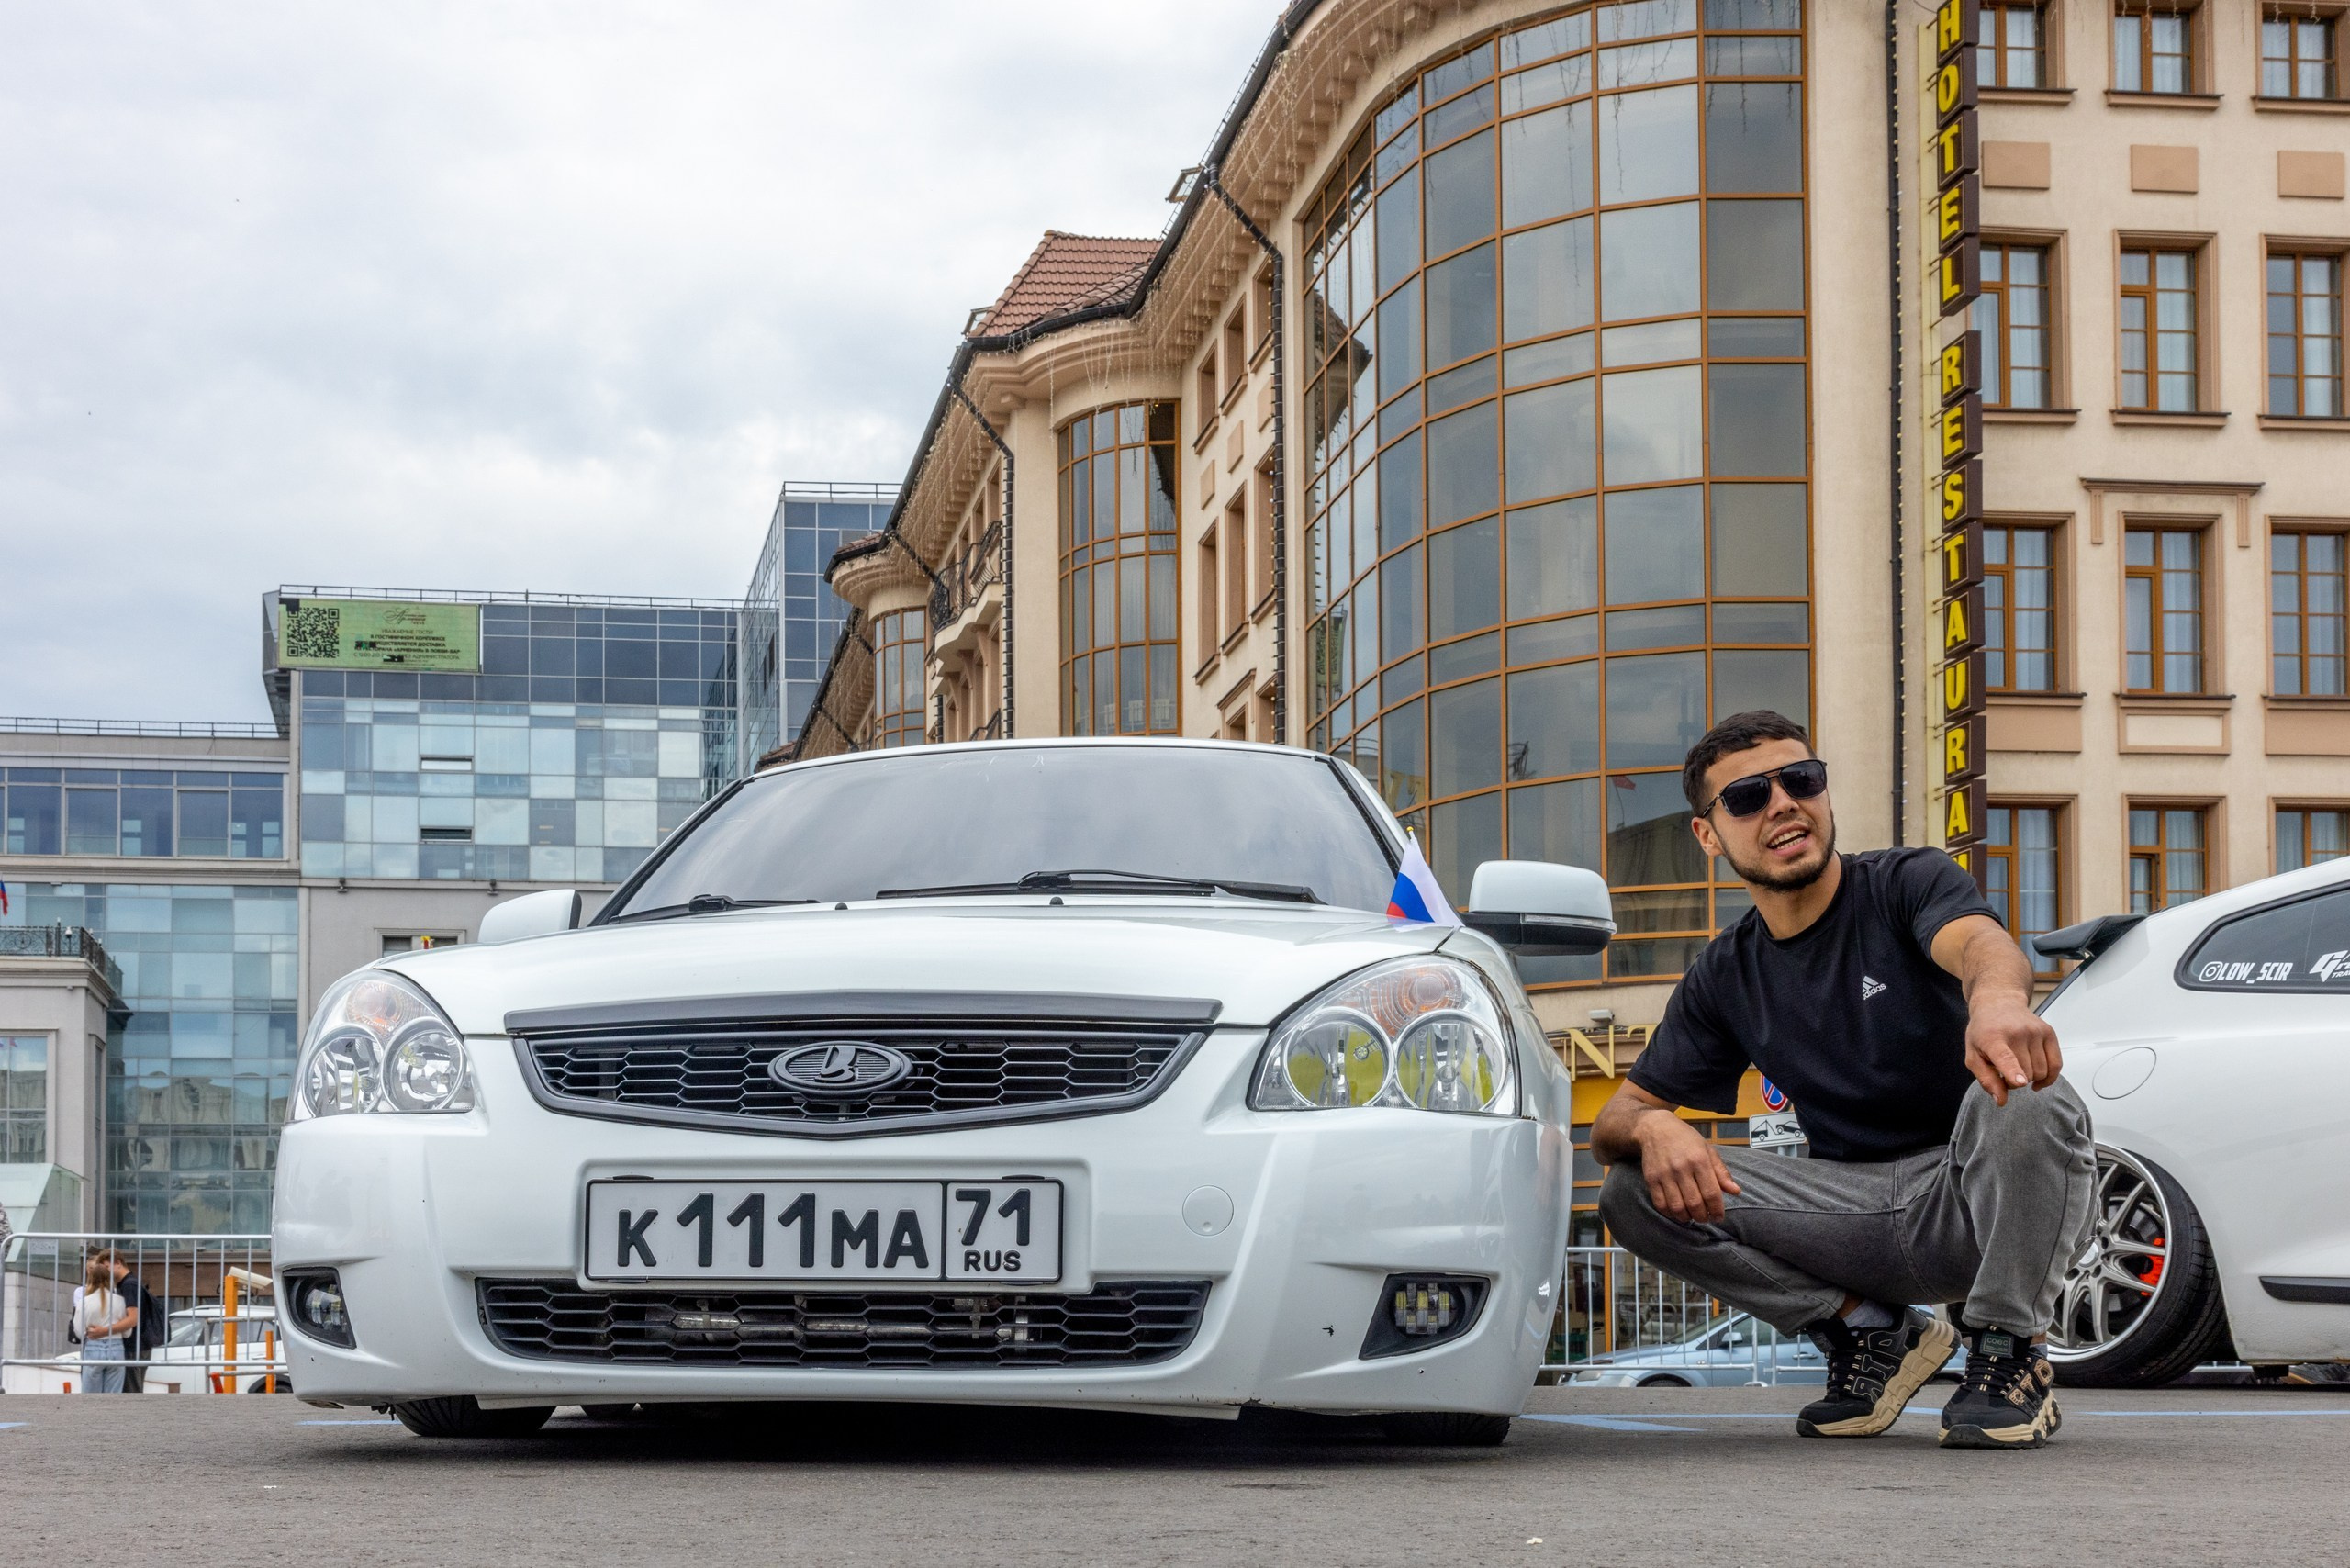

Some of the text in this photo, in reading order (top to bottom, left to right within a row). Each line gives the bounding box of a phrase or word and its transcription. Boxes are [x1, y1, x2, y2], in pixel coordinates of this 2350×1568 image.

[1938, 0, 1969, 870] HOTEL RESTAURA
[617, 1187, 1032, 1269] К111МА 71
[964, 1249, 1022, 1273] RUS
